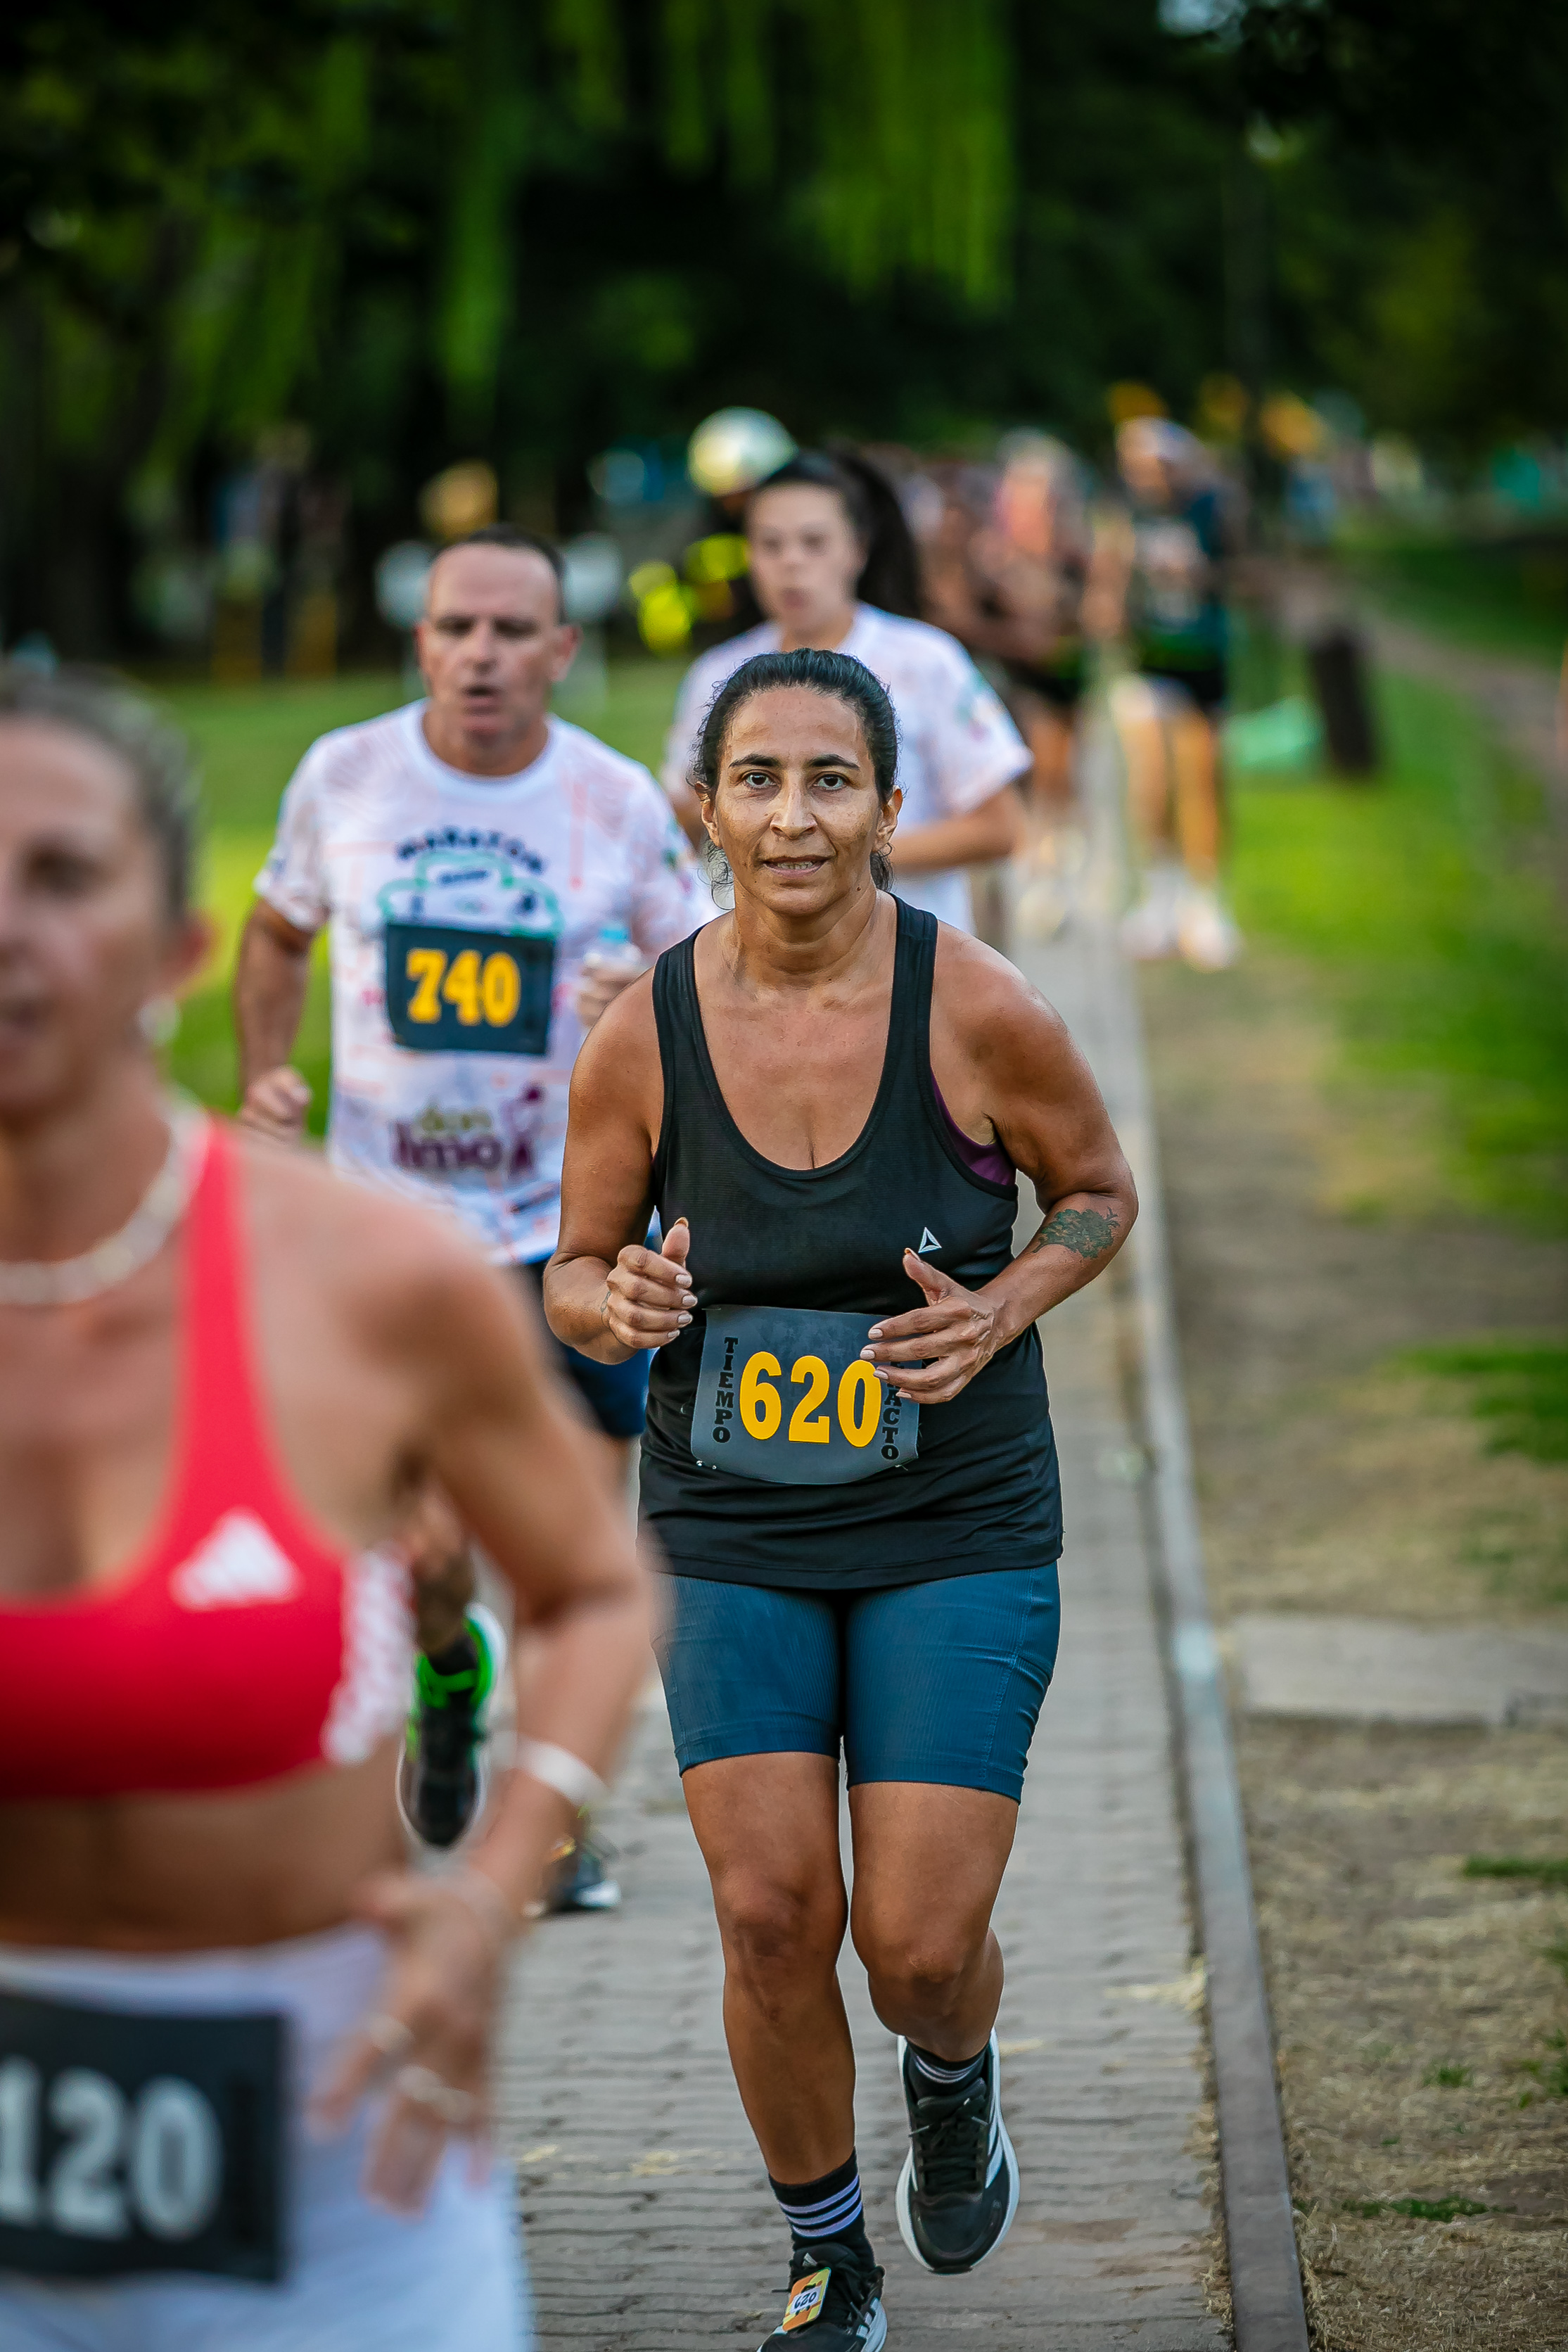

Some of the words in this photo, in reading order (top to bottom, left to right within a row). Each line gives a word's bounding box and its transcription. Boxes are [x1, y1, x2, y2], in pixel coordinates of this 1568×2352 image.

[406, 948, 518, 1026] 740
[712, 1337, 739, 1443] TIEMPO
[739, 1351, 882, 1448] 620
[881, 1361, 905, 1460] ACTO
[793, 2291, 817, 2309] 620
